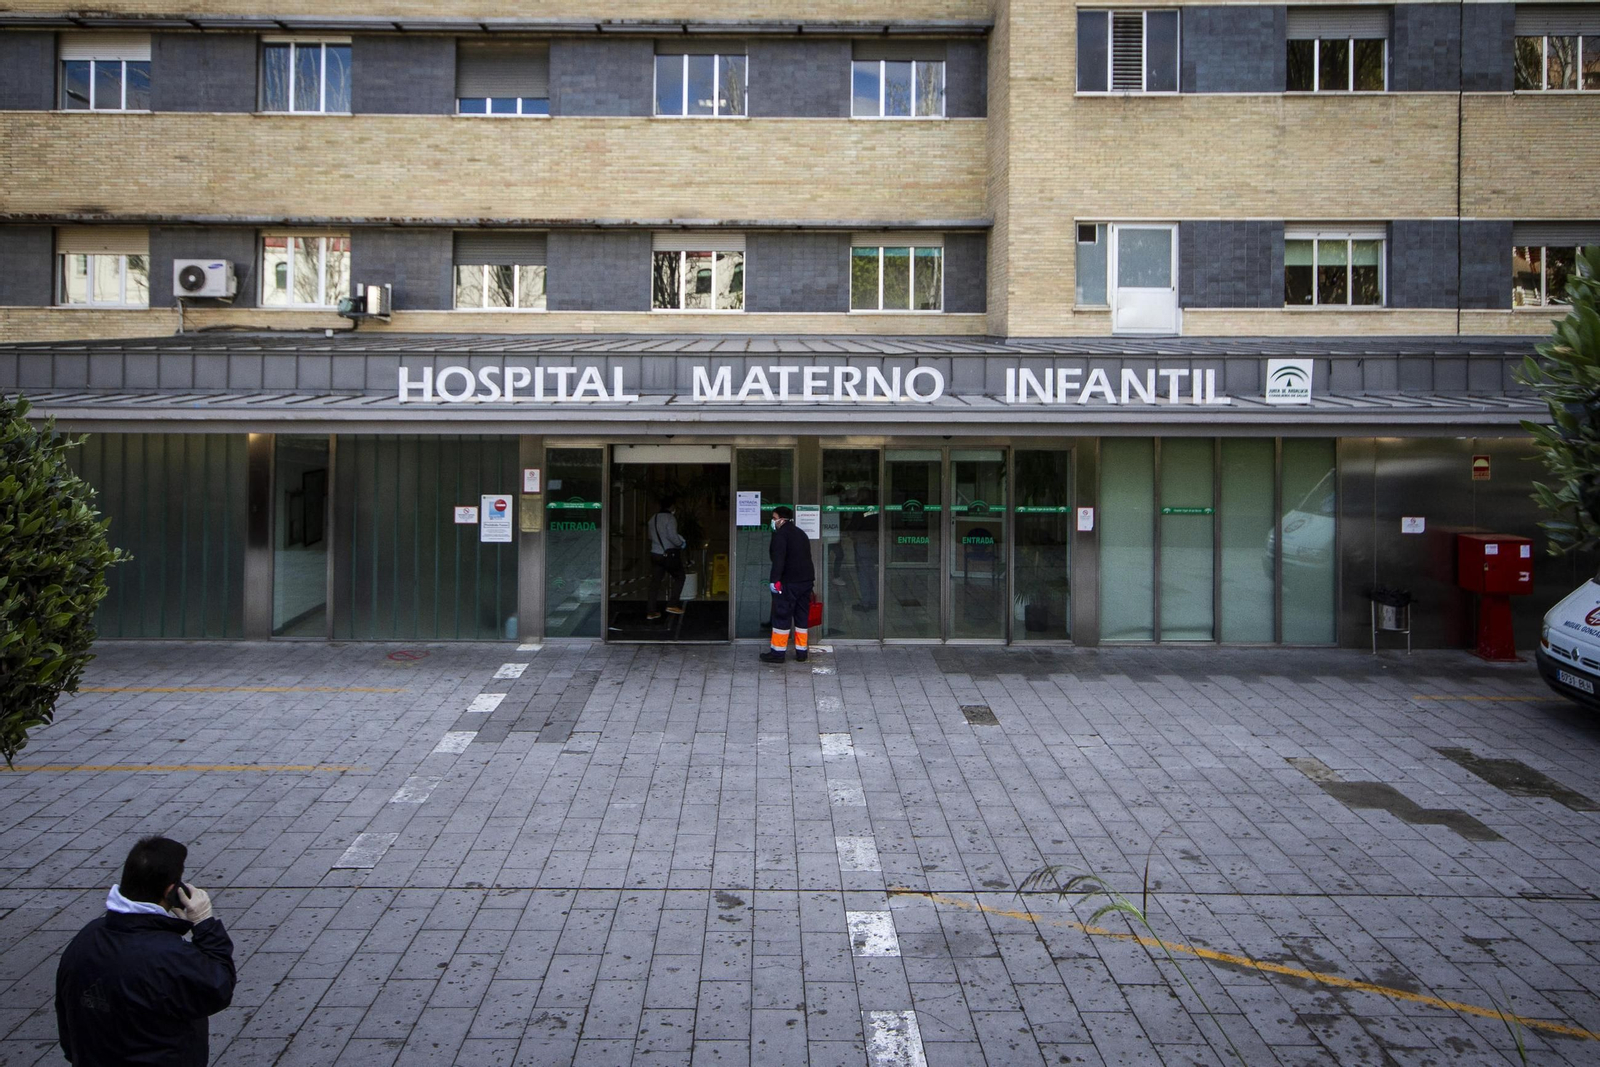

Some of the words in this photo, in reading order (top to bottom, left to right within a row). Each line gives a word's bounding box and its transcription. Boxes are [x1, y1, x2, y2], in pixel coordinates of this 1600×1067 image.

[398, 366, 639, 402] HOSPITAL
[693, 365, 945, 402] MATERNO
[1006, 367, 1231, 404] INFANTIL
[550, 521, 597, 531] ENTRADA
[898, 536, 930, 544] ENTRADA
[962, 536, 994, 545] ENTRADA
[1563, 620, 1581, 630] MIGUEL
